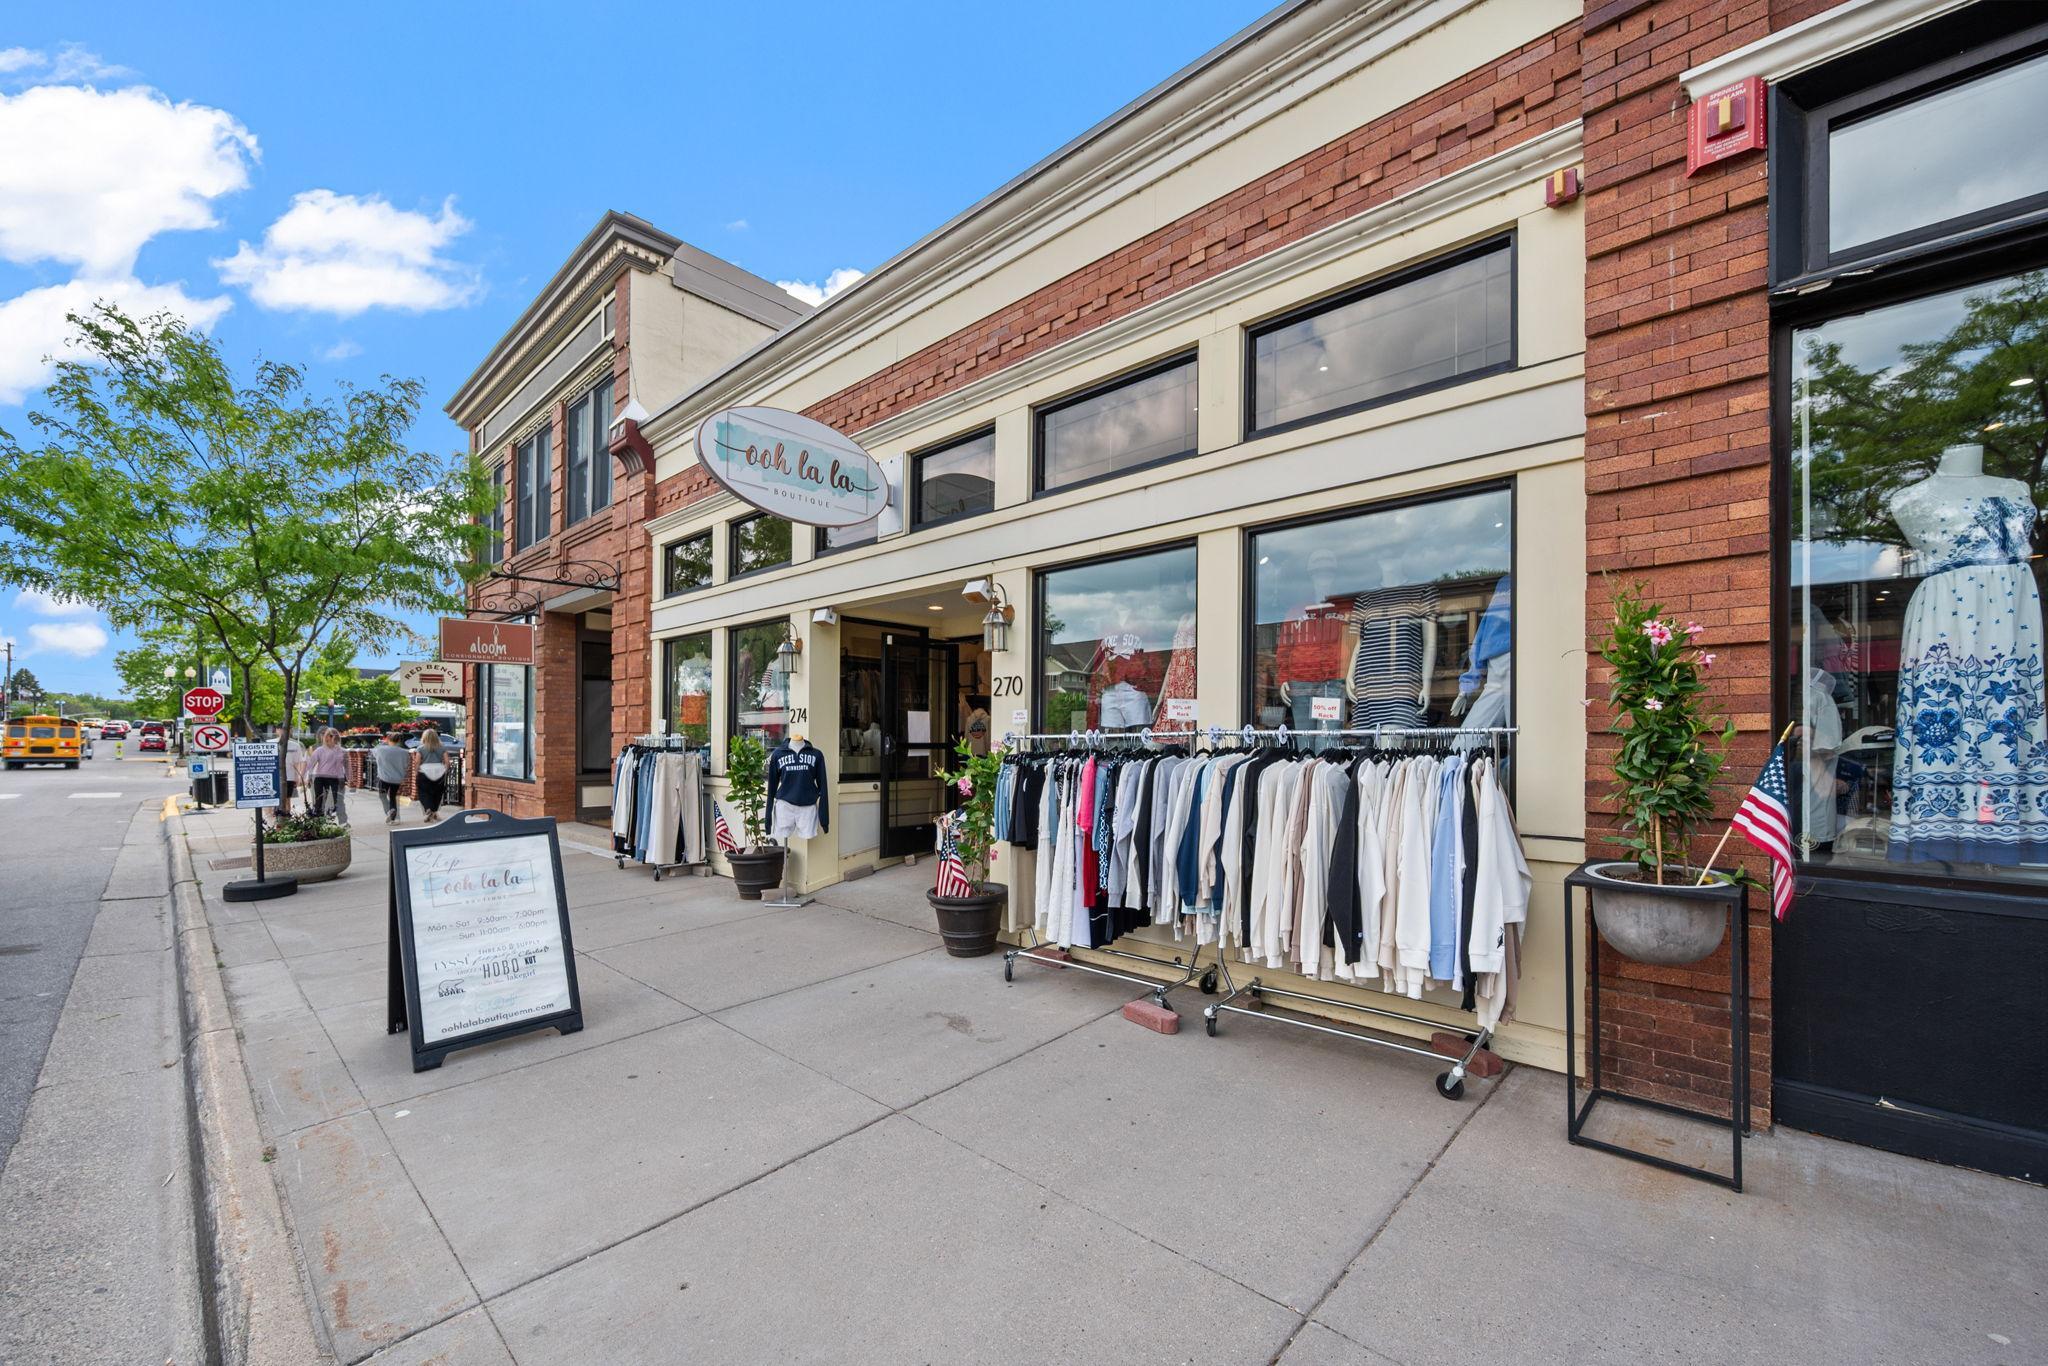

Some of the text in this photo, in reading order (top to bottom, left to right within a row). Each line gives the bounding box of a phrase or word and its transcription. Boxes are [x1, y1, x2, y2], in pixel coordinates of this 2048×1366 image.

[1709, 82, 1744, 100] SPRINKLER
[745, 442, 855, 493] ooh la la
[773, 488, 831, 508] BOUTIQUE
[470, 636, 507, 656] aloom
[404, 664, 459, 682] RED BENCH
[993, 675, 1023, 697] 270
[186, 696, 221, 708] STOP
[790, 708, 807, 724] 274
[778, 754, 796, 769] EXCEL
[414, 850, 461, 876] Shop
[443, 869, 522, 895] ooh la la
[427, 921, 447, 933] Mon
[455, 920, 470, 929] Sat
[514, 908, 545, 920] 7:00pm
[458, 931, 475, 940] Sun
[480, 926, 511, 937] 11:00am
[518, 919, 548, 930] 6:00pm
[482, 957, 520, 979] HOBO
[524, 955, 537, 965] KUT
[441, 1002, 554, 1034] oohlalaboutiquemn.com
